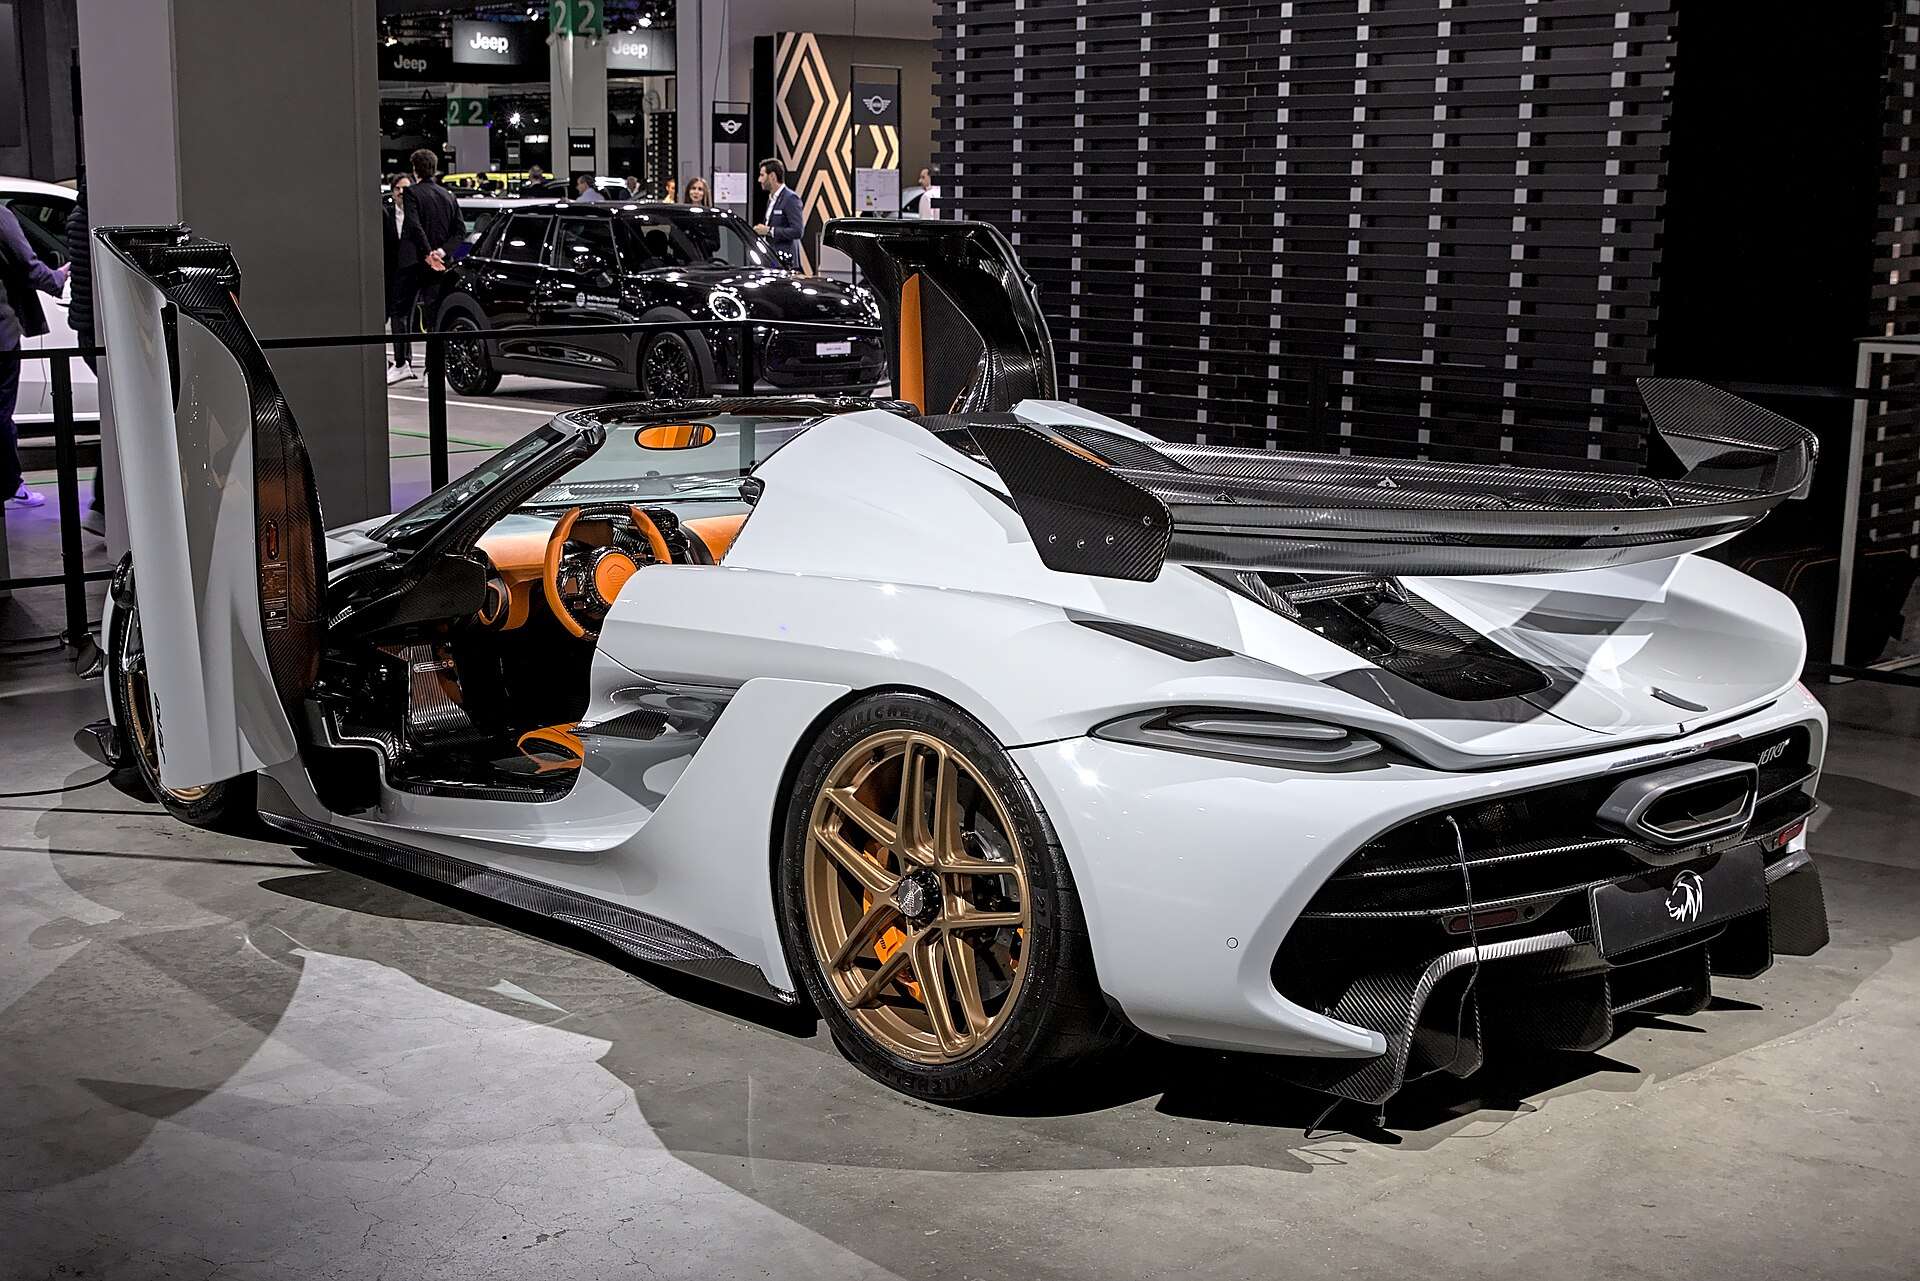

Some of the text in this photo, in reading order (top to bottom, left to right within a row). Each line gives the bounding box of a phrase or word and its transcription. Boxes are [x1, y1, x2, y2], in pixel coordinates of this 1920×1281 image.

[470, 32, 509, 53] Jeep
[612, 40, 648, 59] Jeep
[394, 54, 427, 72] Jeep
[468, 101, 483, 124] 2
